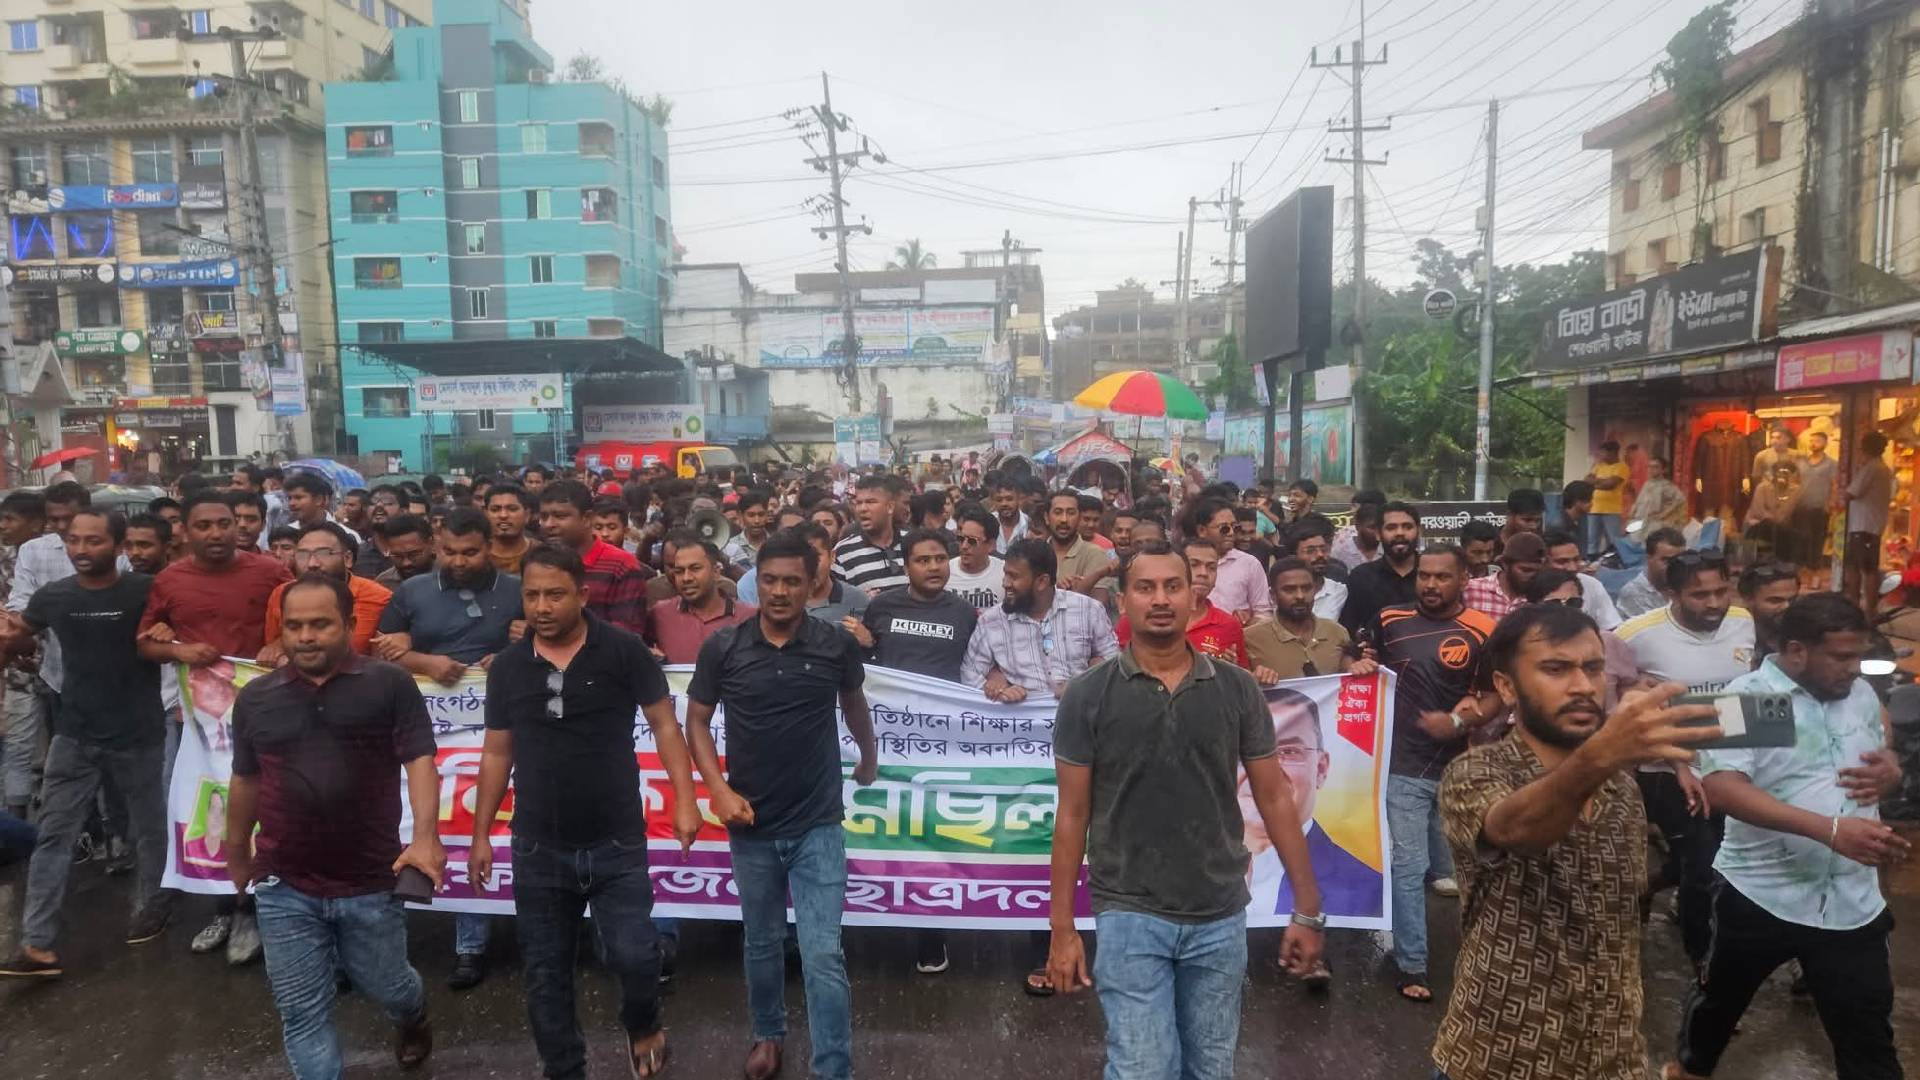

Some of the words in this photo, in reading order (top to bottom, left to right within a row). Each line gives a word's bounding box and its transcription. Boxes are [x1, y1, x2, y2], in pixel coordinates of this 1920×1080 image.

[1558, 307, 1595, 338] বিয়ে
[1600, 288, 1646, 329] বাড়ী
[869, 704, 950, 731] তিষ্ঠানে
[961, 712, 1033, 734] শিক্ষার
[957, 738, 1051, 758] অবনতির
